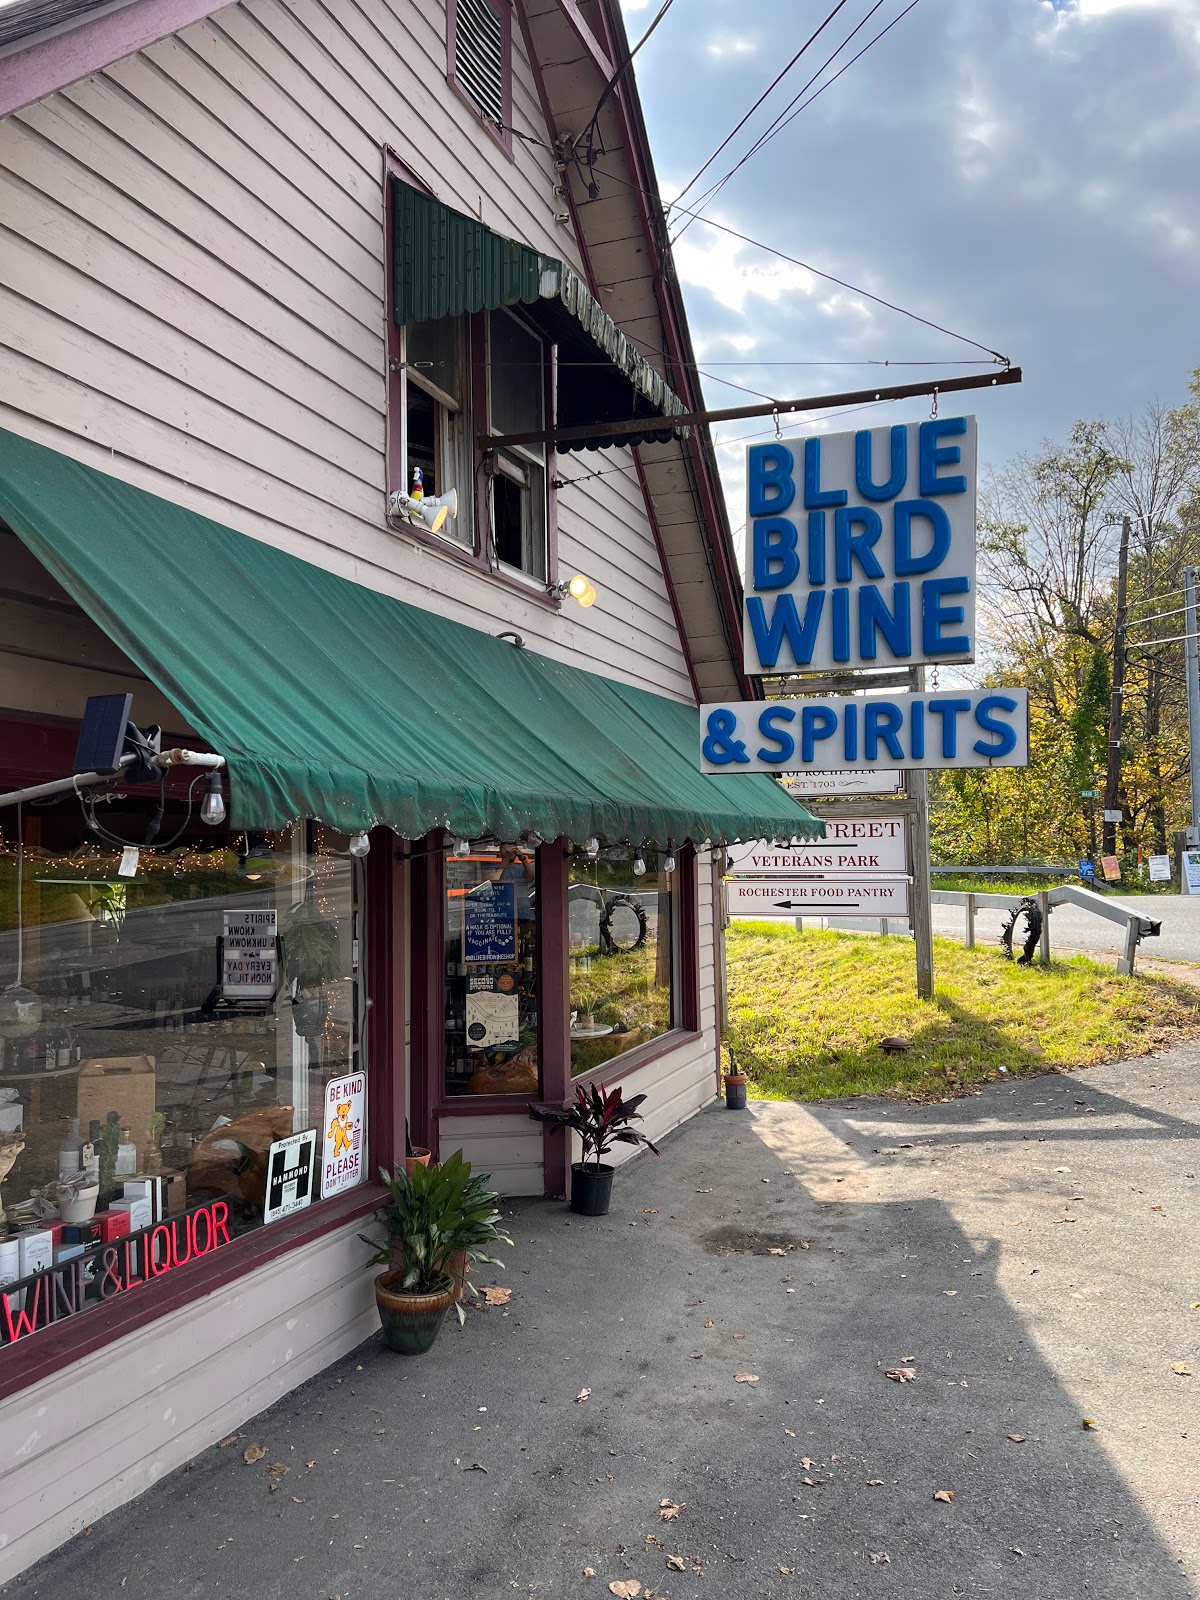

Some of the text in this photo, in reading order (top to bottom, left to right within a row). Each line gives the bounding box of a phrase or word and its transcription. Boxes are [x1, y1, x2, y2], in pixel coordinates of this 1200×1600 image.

[749, 417, 967, 517] BLUE
[753, 499, 951, 591] BIRD
[746, 576, 972, 668] WINE
[757, 696, 1018, 763] SPIRITS
[752, 856, 880, 867] VETERANS PARK
[738, 888, 895, 897] ROCHESTER FOOD PANTRY
[330, 1079, 362, 1102] BE KIND
[278, 1134, 309, 1149] Protected By
[272, 1165, 308, 1186] HAMMOND
[326, 1153, 359, 1178] PLEASE
[325, 1175, 341, 1190] DON'T
[342, 1168, 359, 1182] LITTER
[101, 1247, 123, 1299] &
[125, 1201, 231, 1291] LIQUOR
